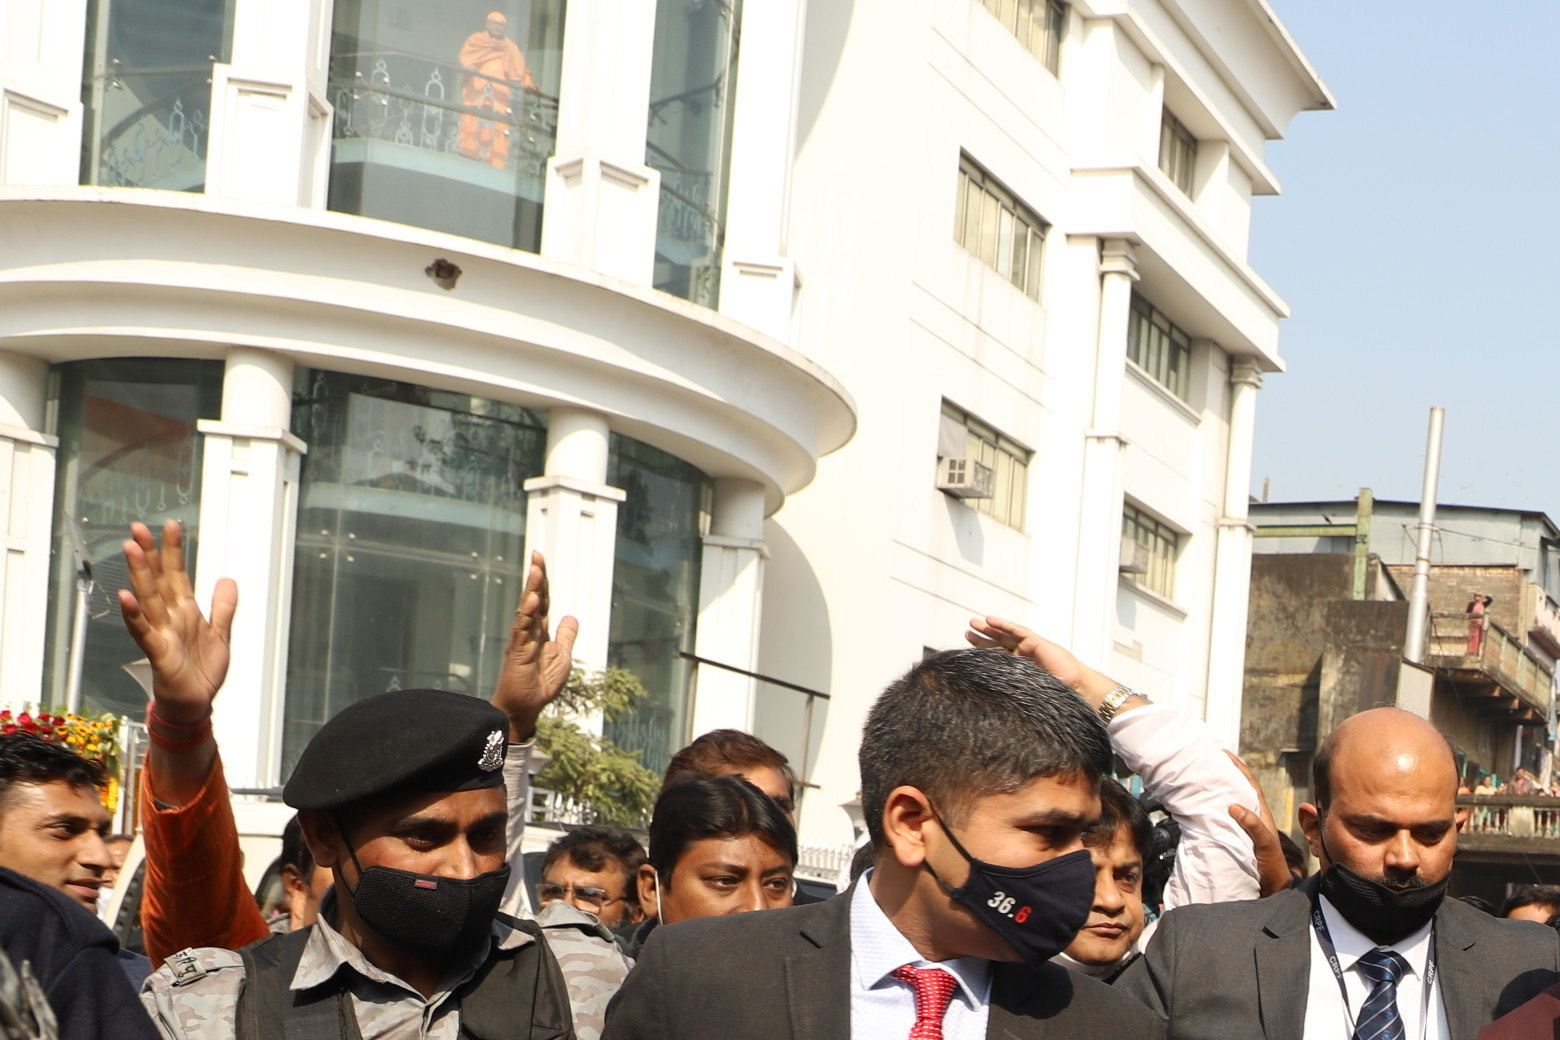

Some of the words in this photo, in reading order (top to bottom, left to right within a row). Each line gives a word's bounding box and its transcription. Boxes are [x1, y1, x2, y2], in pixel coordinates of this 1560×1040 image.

[987, 891, 1033, 923] 36.6
[1313, 910, 1325, 932] CRPF
[1427, 959, 1435, 985] CRPF
